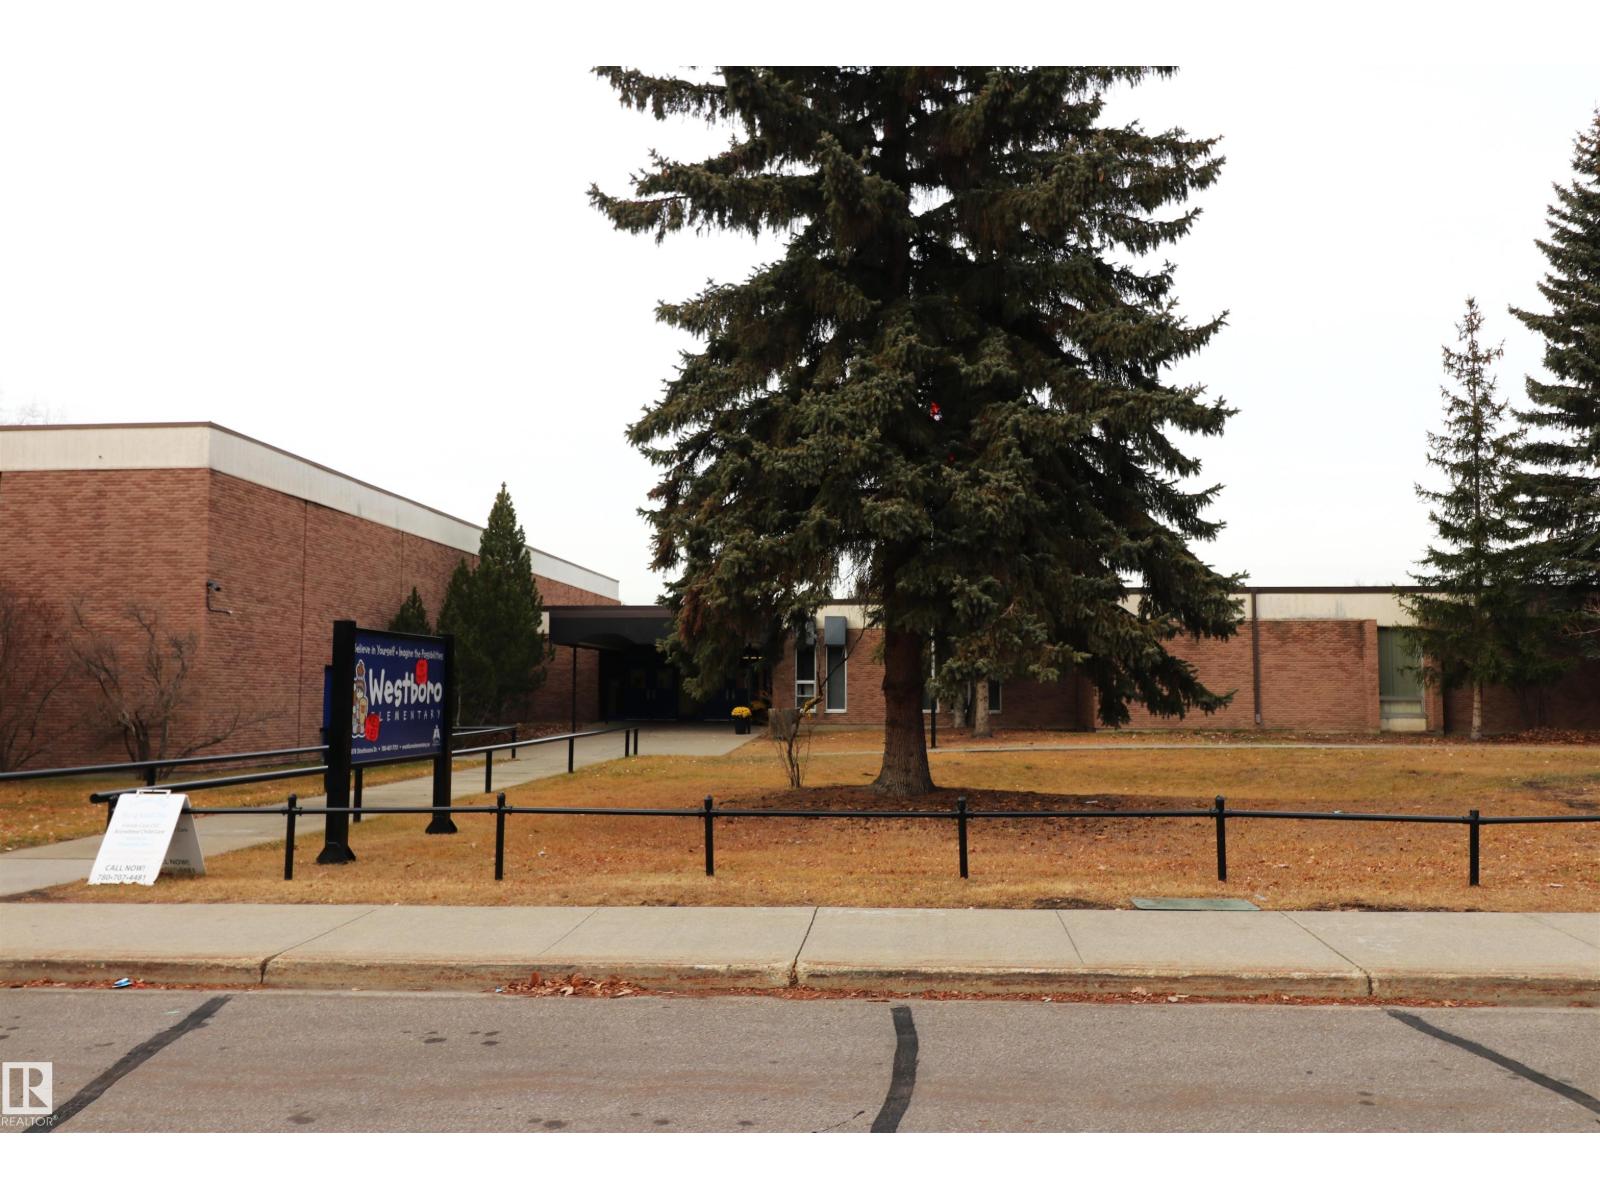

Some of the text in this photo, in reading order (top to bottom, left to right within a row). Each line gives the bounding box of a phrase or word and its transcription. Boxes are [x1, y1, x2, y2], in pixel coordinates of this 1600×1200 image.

[377, 645, 396, 656] Yourself
[369, 669, 442, 707] Westboro
[371, 710, 440, 721] LEMENTARY
